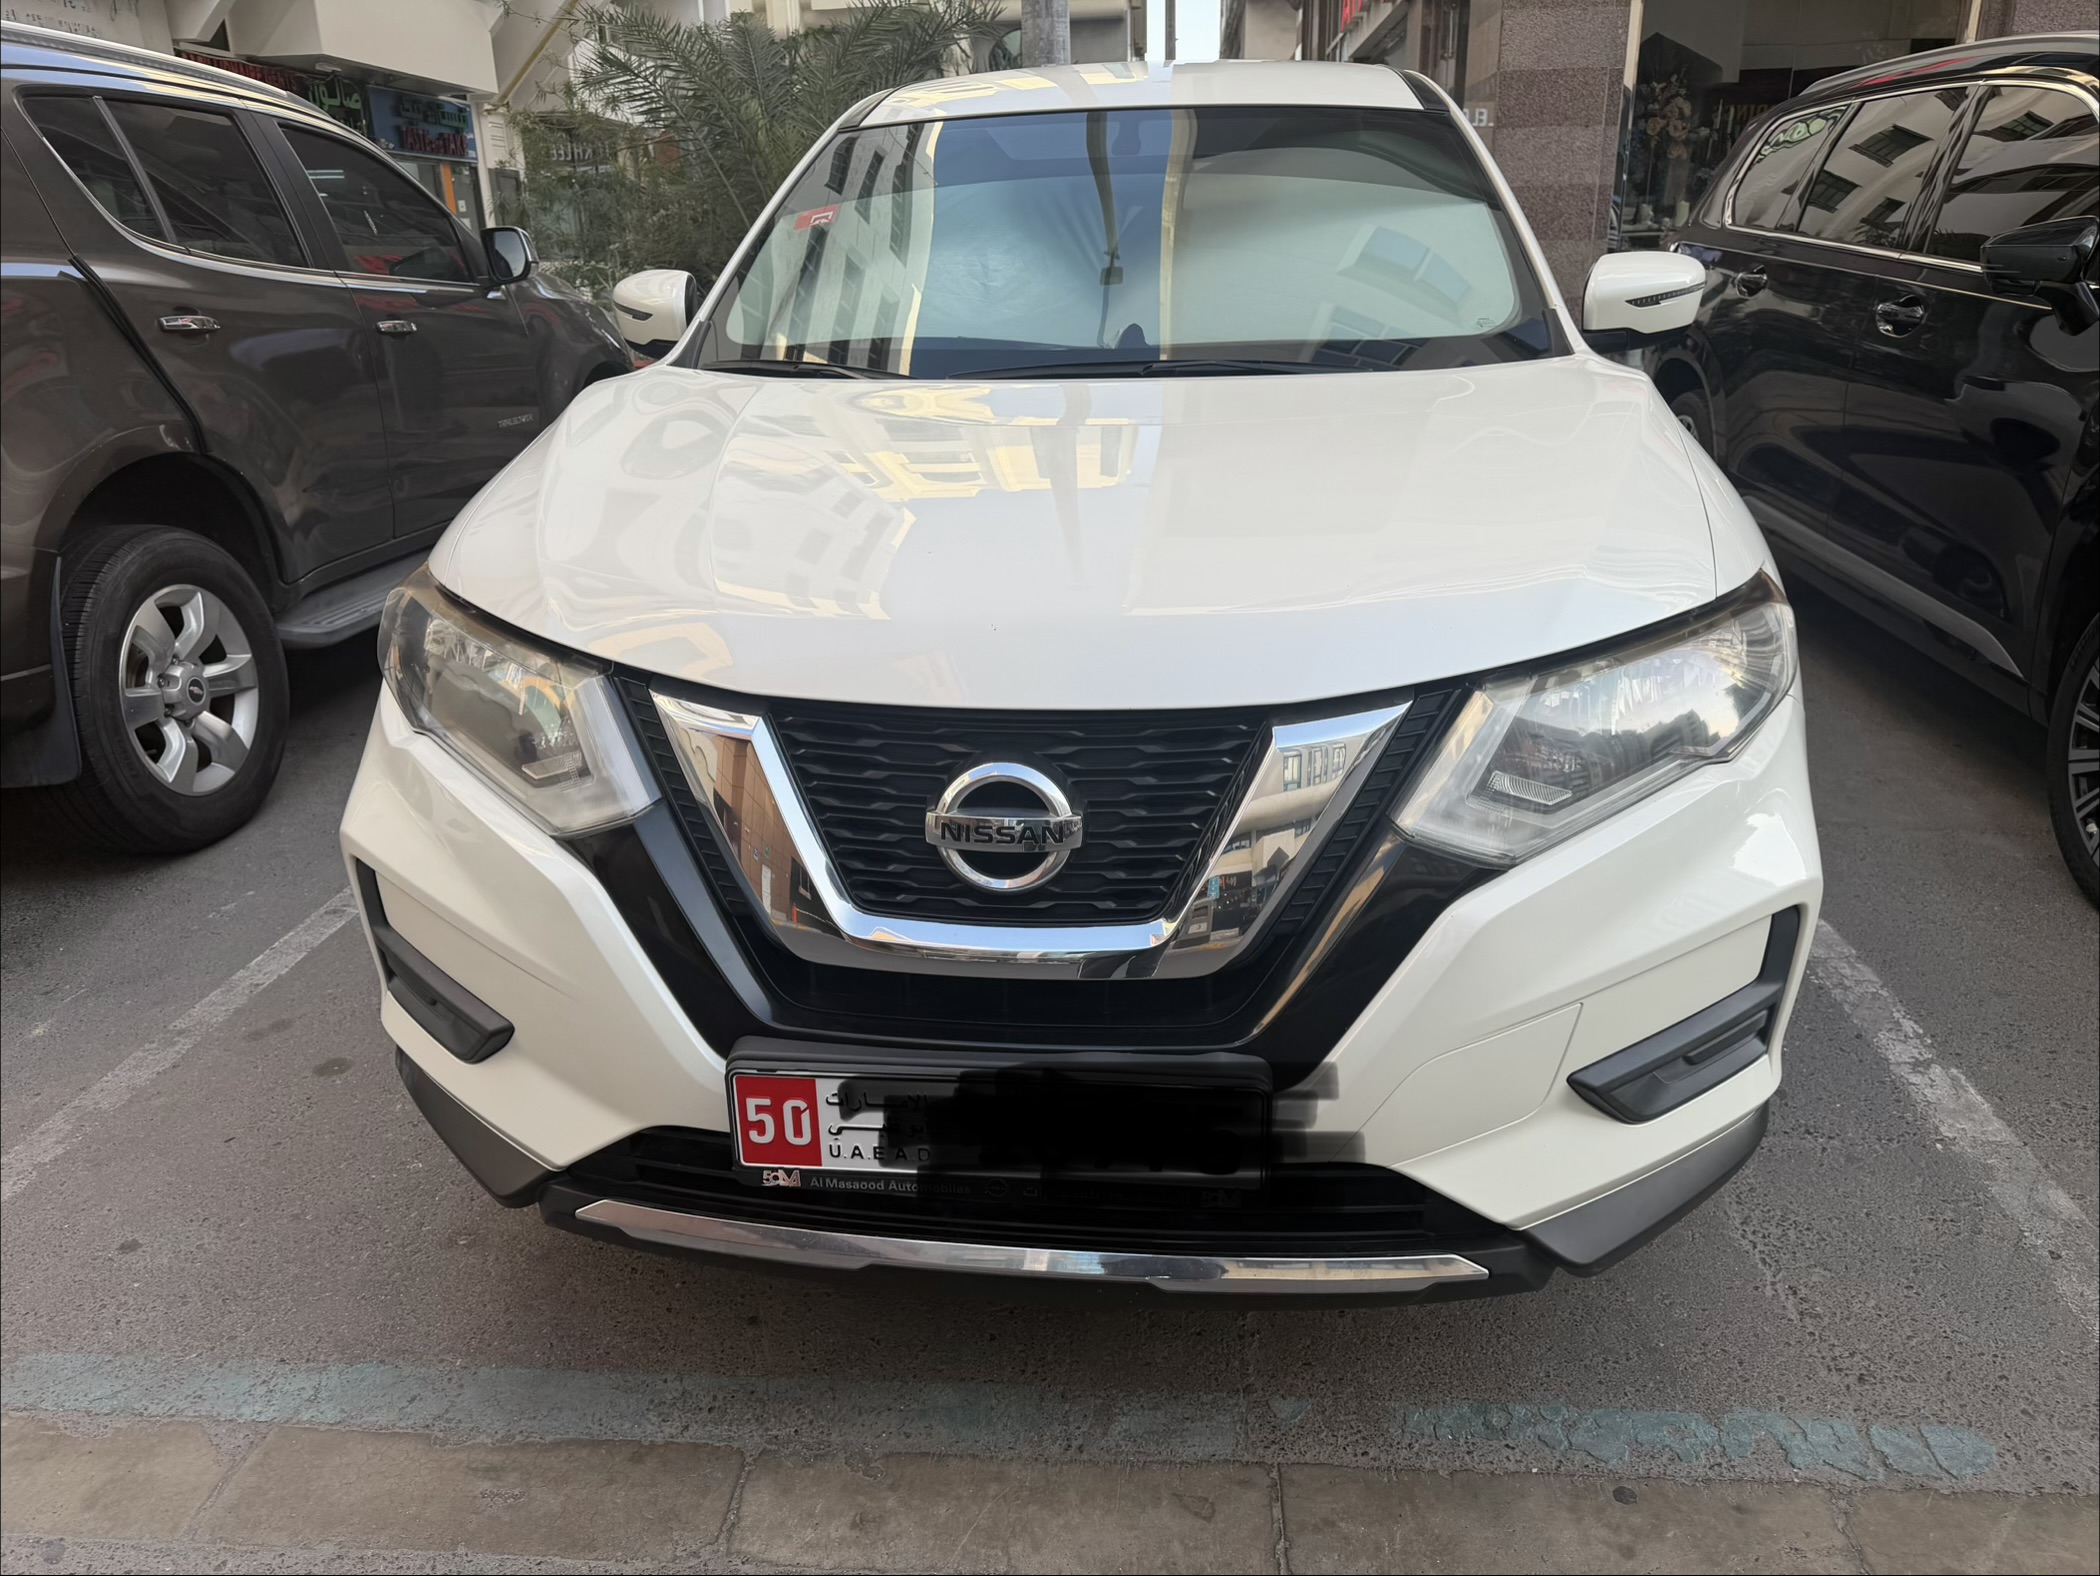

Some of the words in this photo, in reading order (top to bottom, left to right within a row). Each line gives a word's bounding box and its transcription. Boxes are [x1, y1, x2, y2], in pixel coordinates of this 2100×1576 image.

[940, 822, 1064, 845] NISSAN
[745, 1097, 812, 1146] 50
[810, 1176, 824, 1188] Al
[826, 1177, 885, 1191] Masaood
